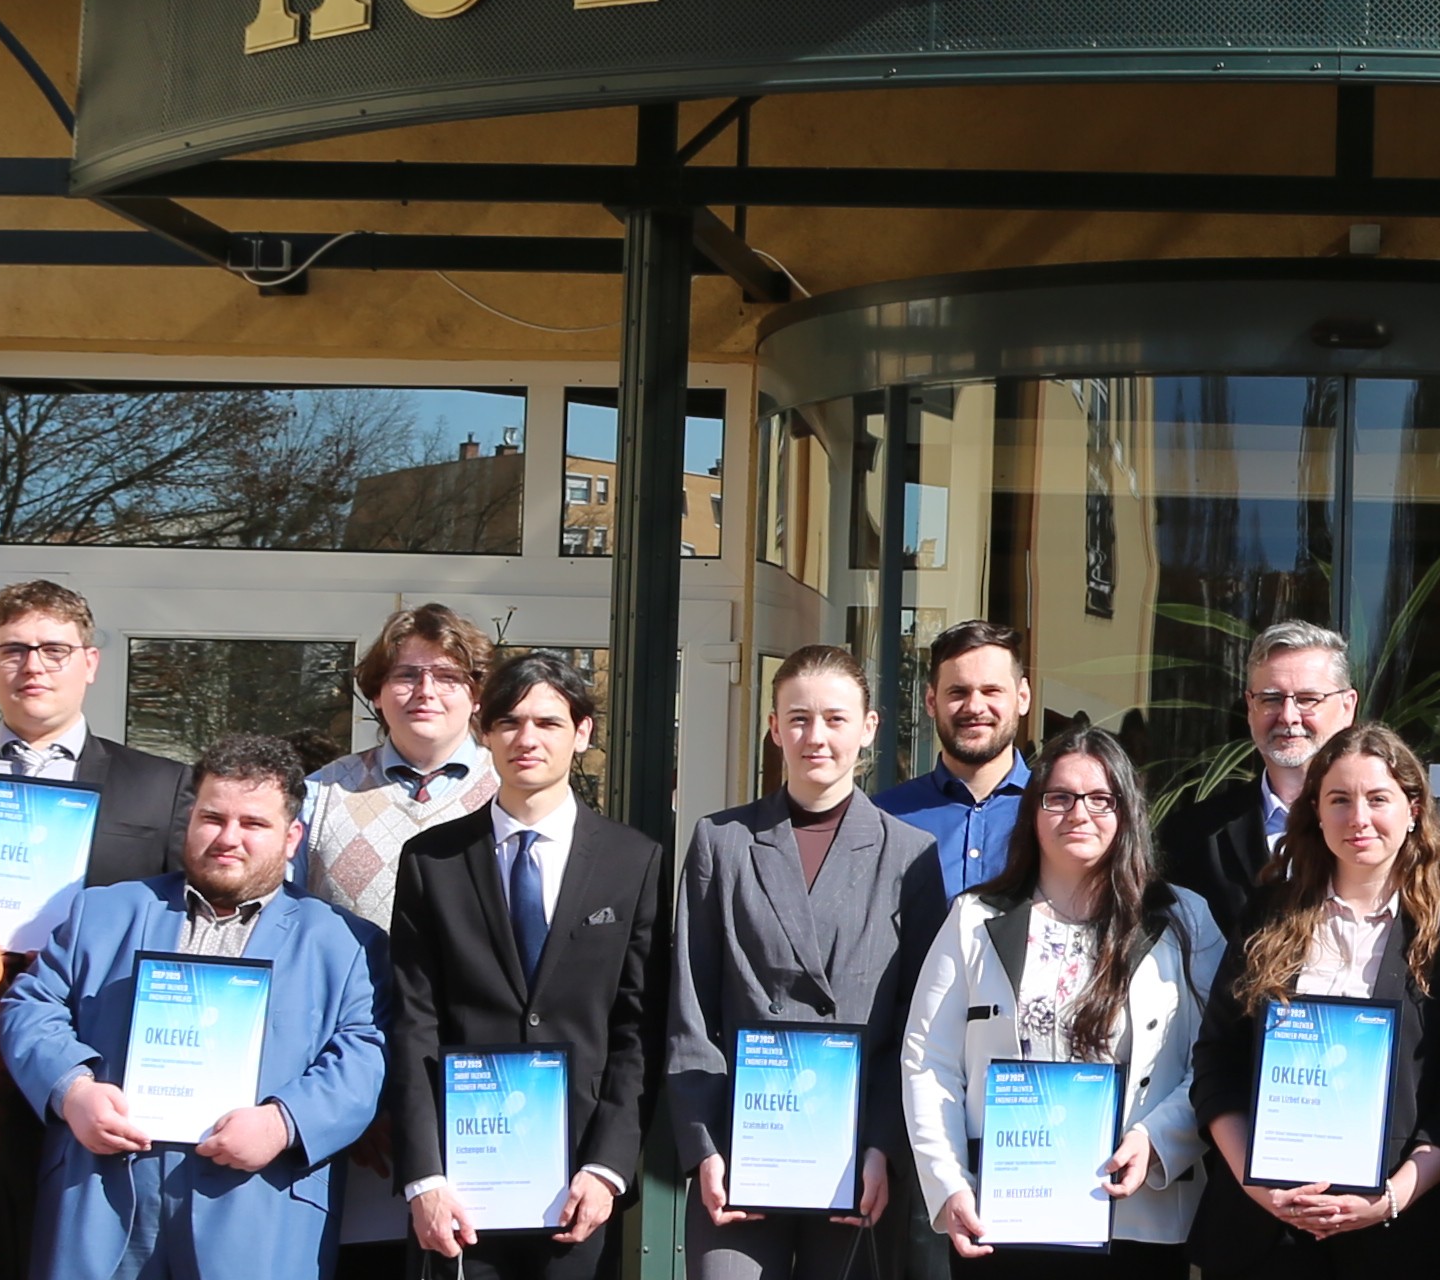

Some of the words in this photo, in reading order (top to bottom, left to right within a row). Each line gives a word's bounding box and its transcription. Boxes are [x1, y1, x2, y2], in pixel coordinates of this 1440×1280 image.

[145, 1025, 200, 1047] OKLEVÉL
[1271, 1064, 1328, 1087] OKLEVÉL
[744, 1089, 800, 1112] OKLEVÉL
[456, 1112, 511, 1135] OKLEVÉL
[996, 1125, 1052, 1148] OKLEVÉL
